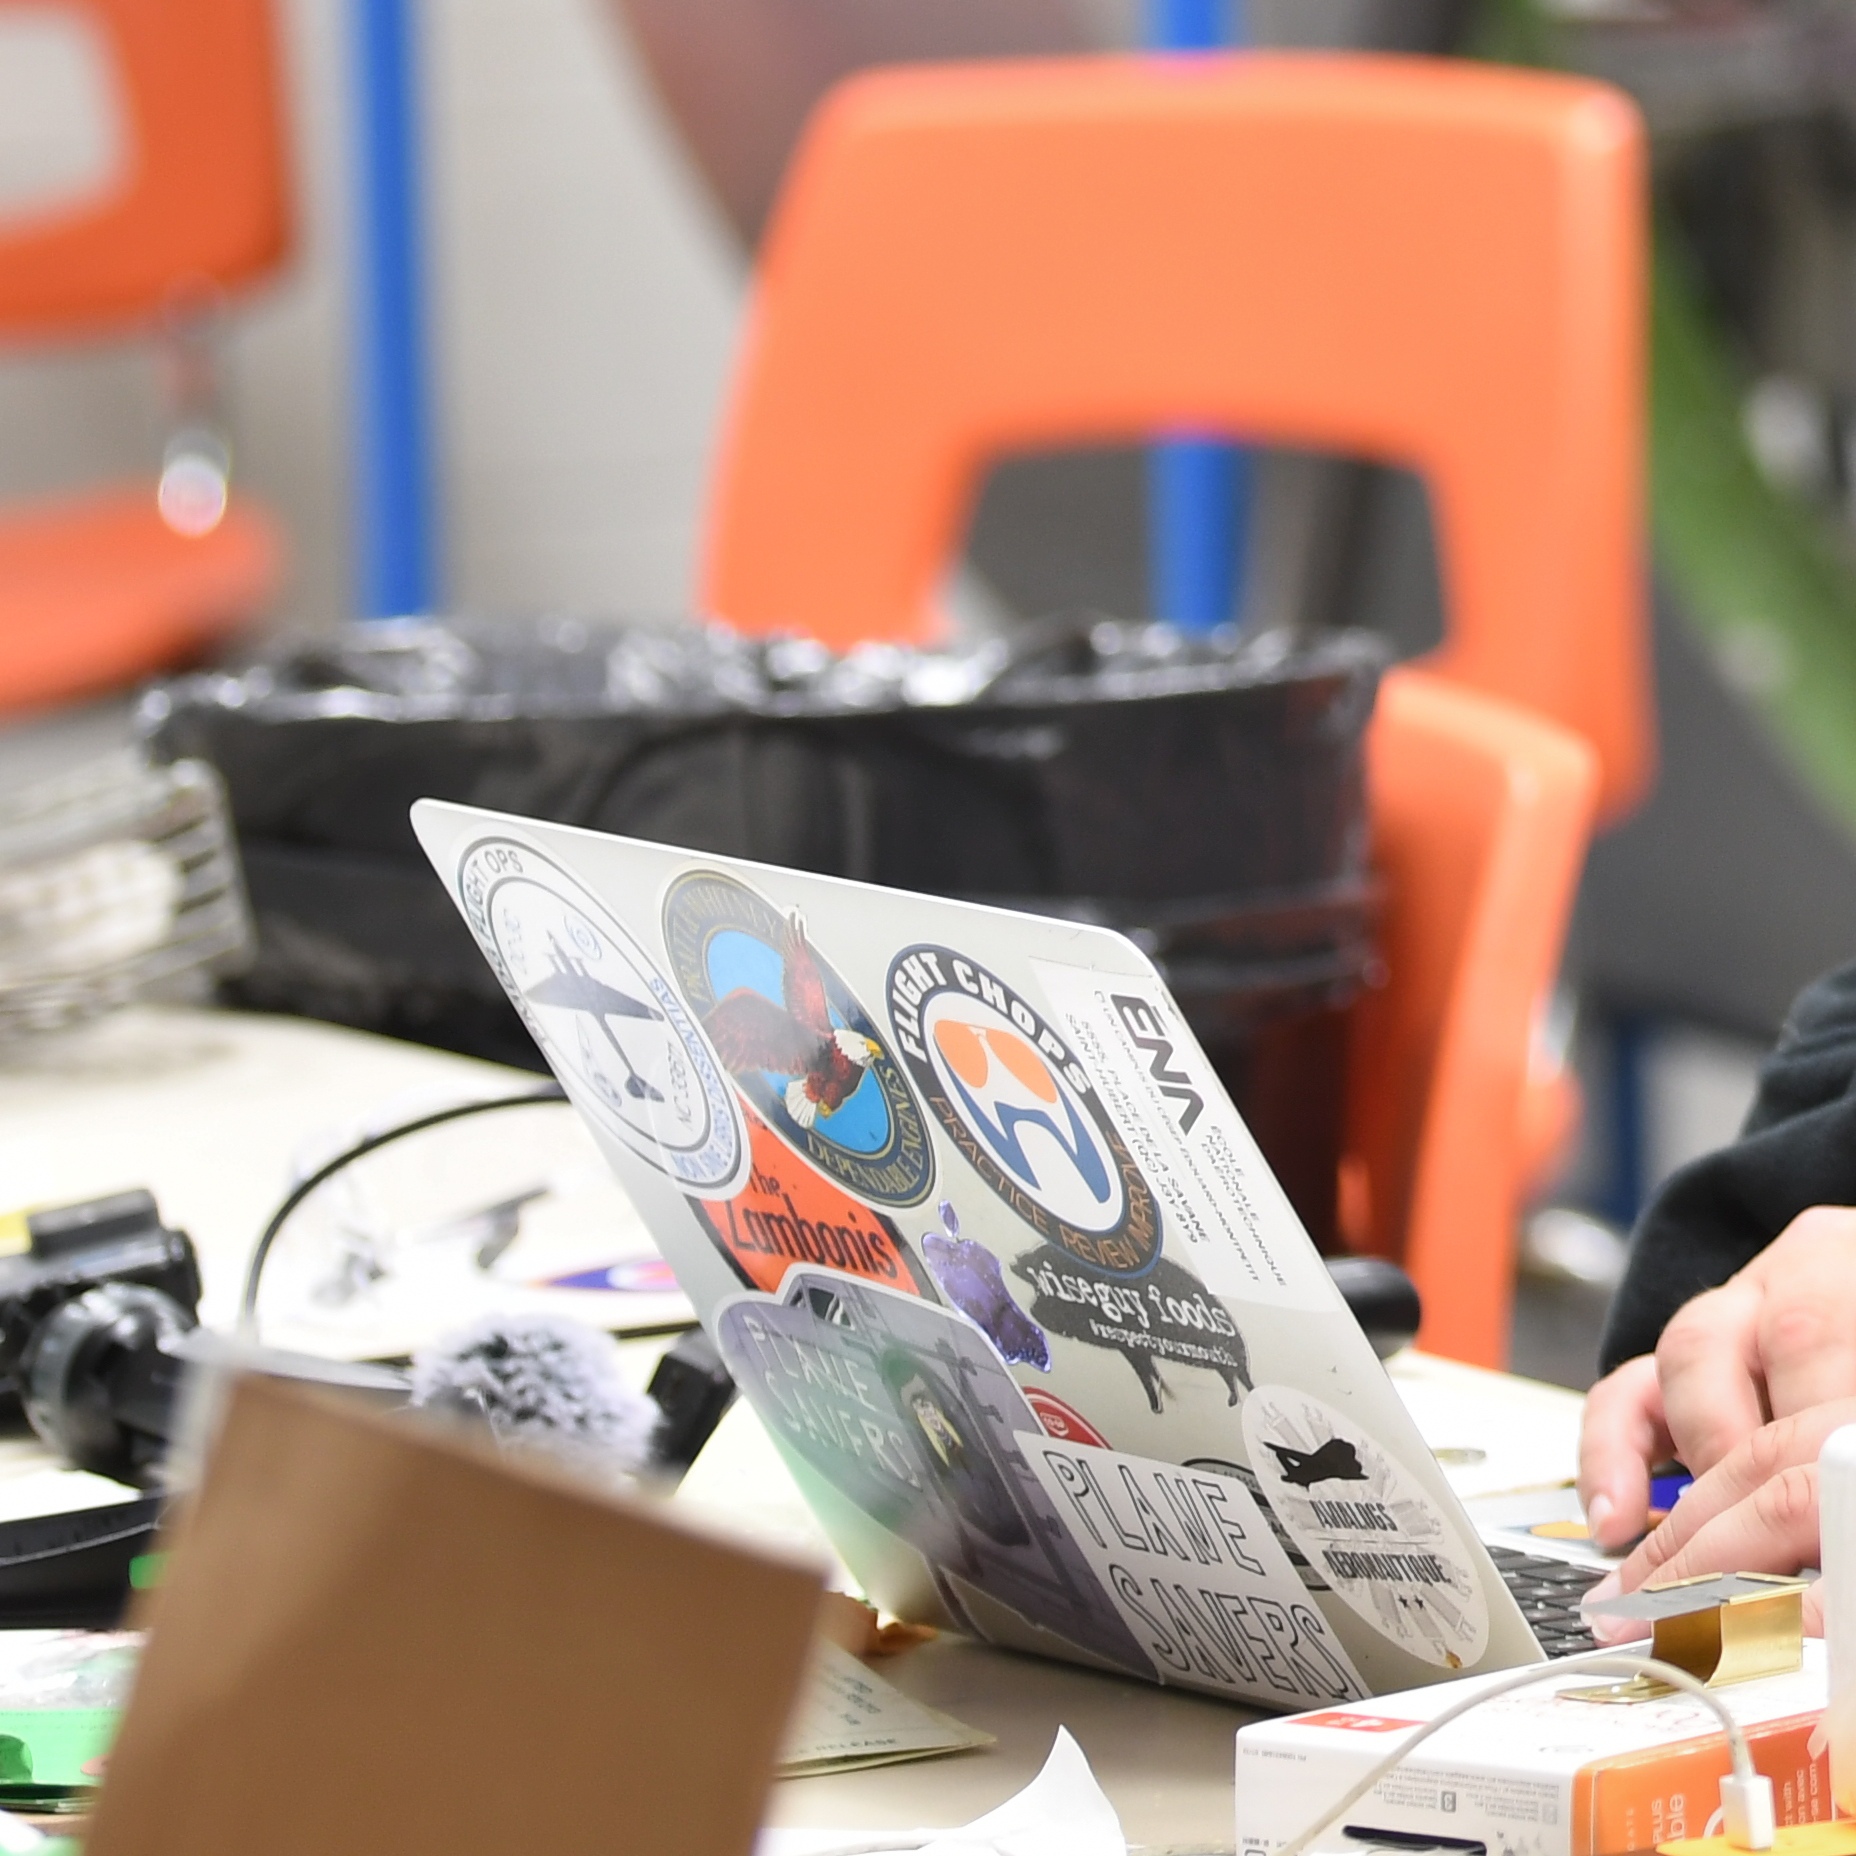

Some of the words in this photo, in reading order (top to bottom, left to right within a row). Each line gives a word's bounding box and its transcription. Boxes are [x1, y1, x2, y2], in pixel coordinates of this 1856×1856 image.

[484, 849, 524, 875] OPS
[892, 952, 947, 1063] FLIGHT
[952, 959, 1093, 1094] CHOPS
[929, 1097, 1050, 1232] PRACTICE
[1059, 1224, 1140, 1269] REVIEW
[1027, 1261, 1150, 1328] wiseguy
[1148, 1284, 1236, 1337] foods
[743, 1315, 877, 1412] PLANE
[765, 1370, 924, 1492] SAVERS
[1042, 1451, 1266, 1576] PLANE
[1309, 1499, 1399, 1532] AVIALOGS
[1109, 1564, 1366, 1701] SAVERS
[1667, 1793, 1685, 1842] ble
